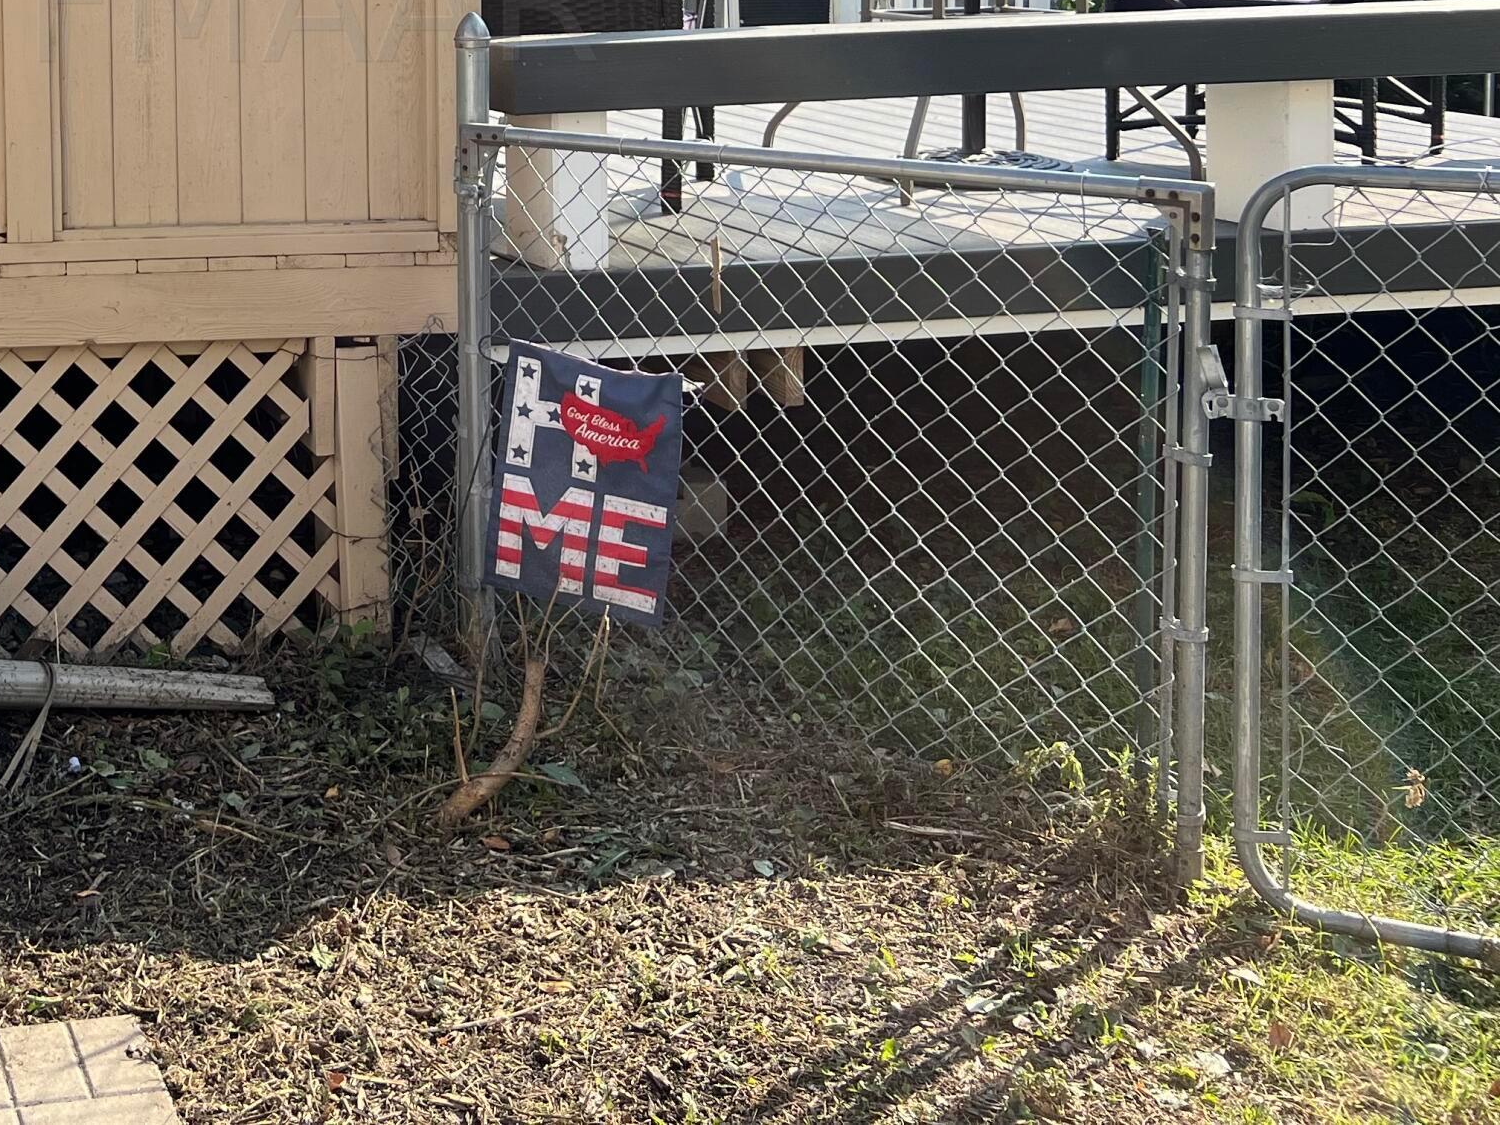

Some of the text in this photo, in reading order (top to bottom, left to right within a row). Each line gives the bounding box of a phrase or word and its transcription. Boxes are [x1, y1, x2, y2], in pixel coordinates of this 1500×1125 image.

[566, 406, 621, 432] God Bless
[574, 423, 641, 451] America
